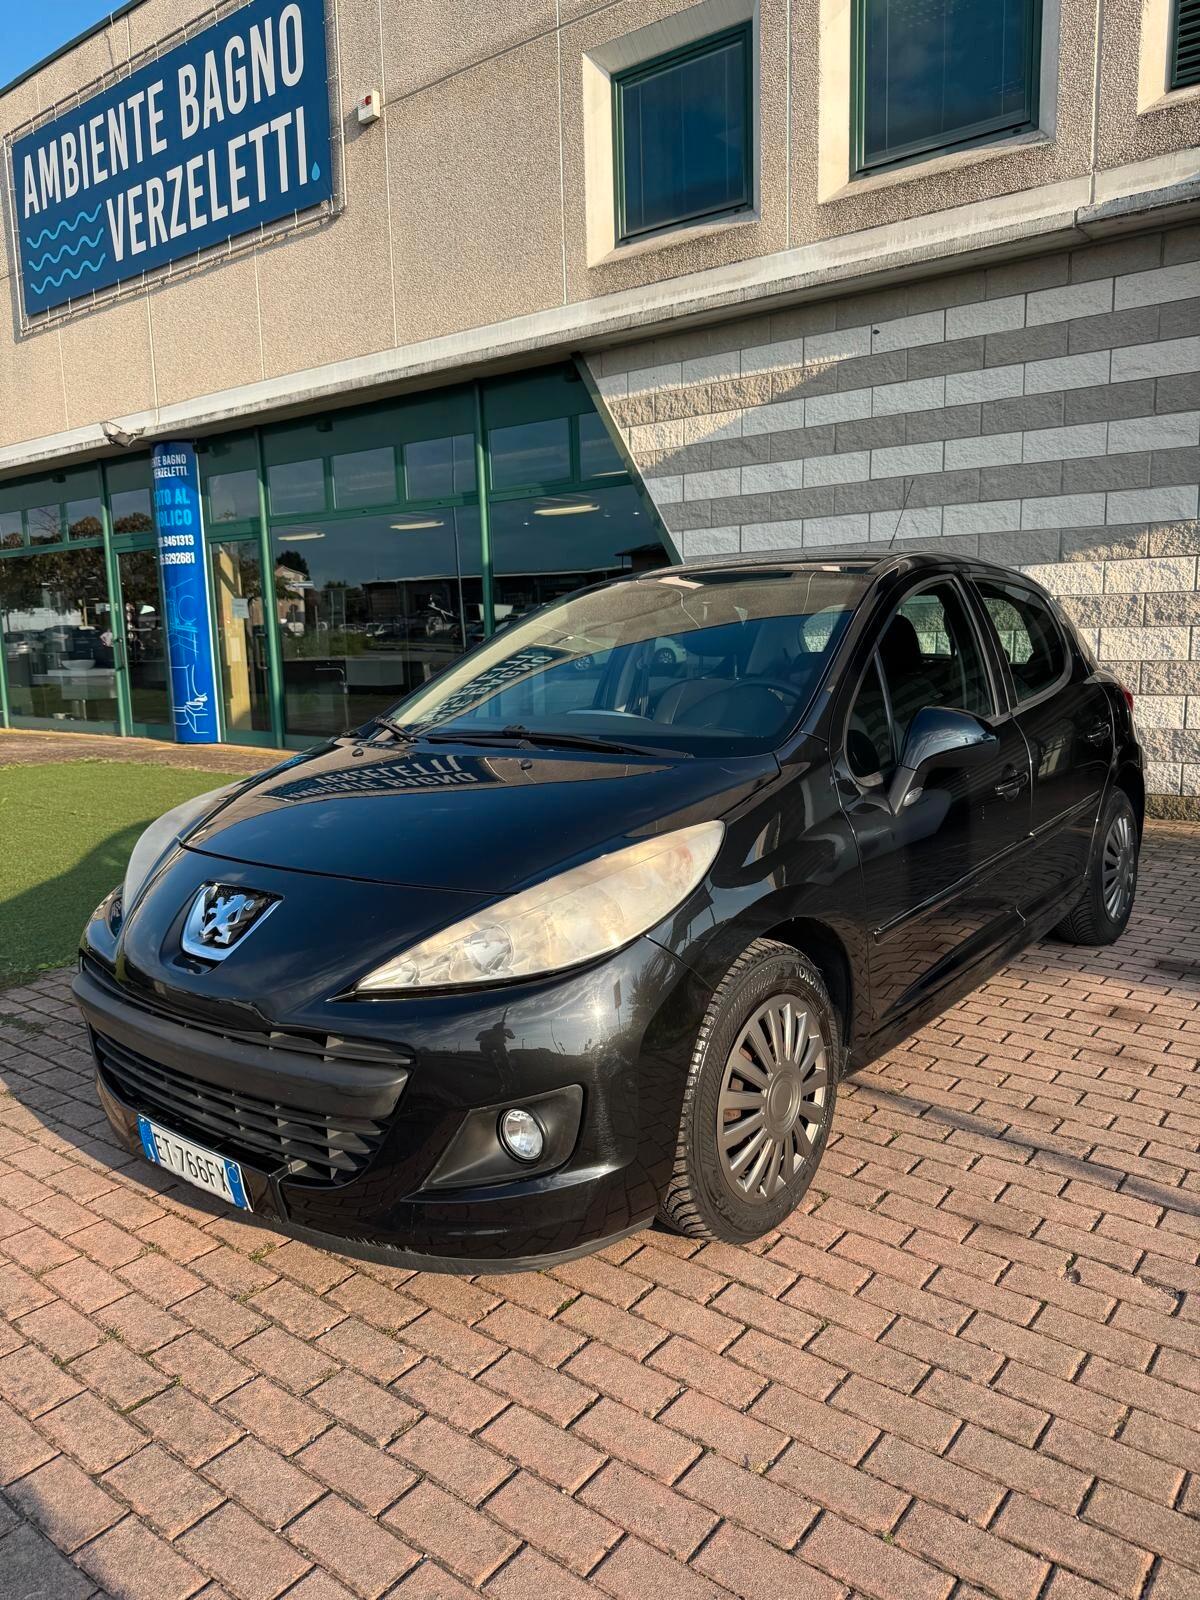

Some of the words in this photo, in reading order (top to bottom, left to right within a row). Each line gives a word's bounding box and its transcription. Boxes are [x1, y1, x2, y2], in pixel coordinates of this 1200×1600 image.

[24, 79, 167, 219] AMBIENTE
[178, 3, 304, 140] BAGNO
[162, 453, 187, 466] BAGNO
[175, 488, 190, 505] AL
